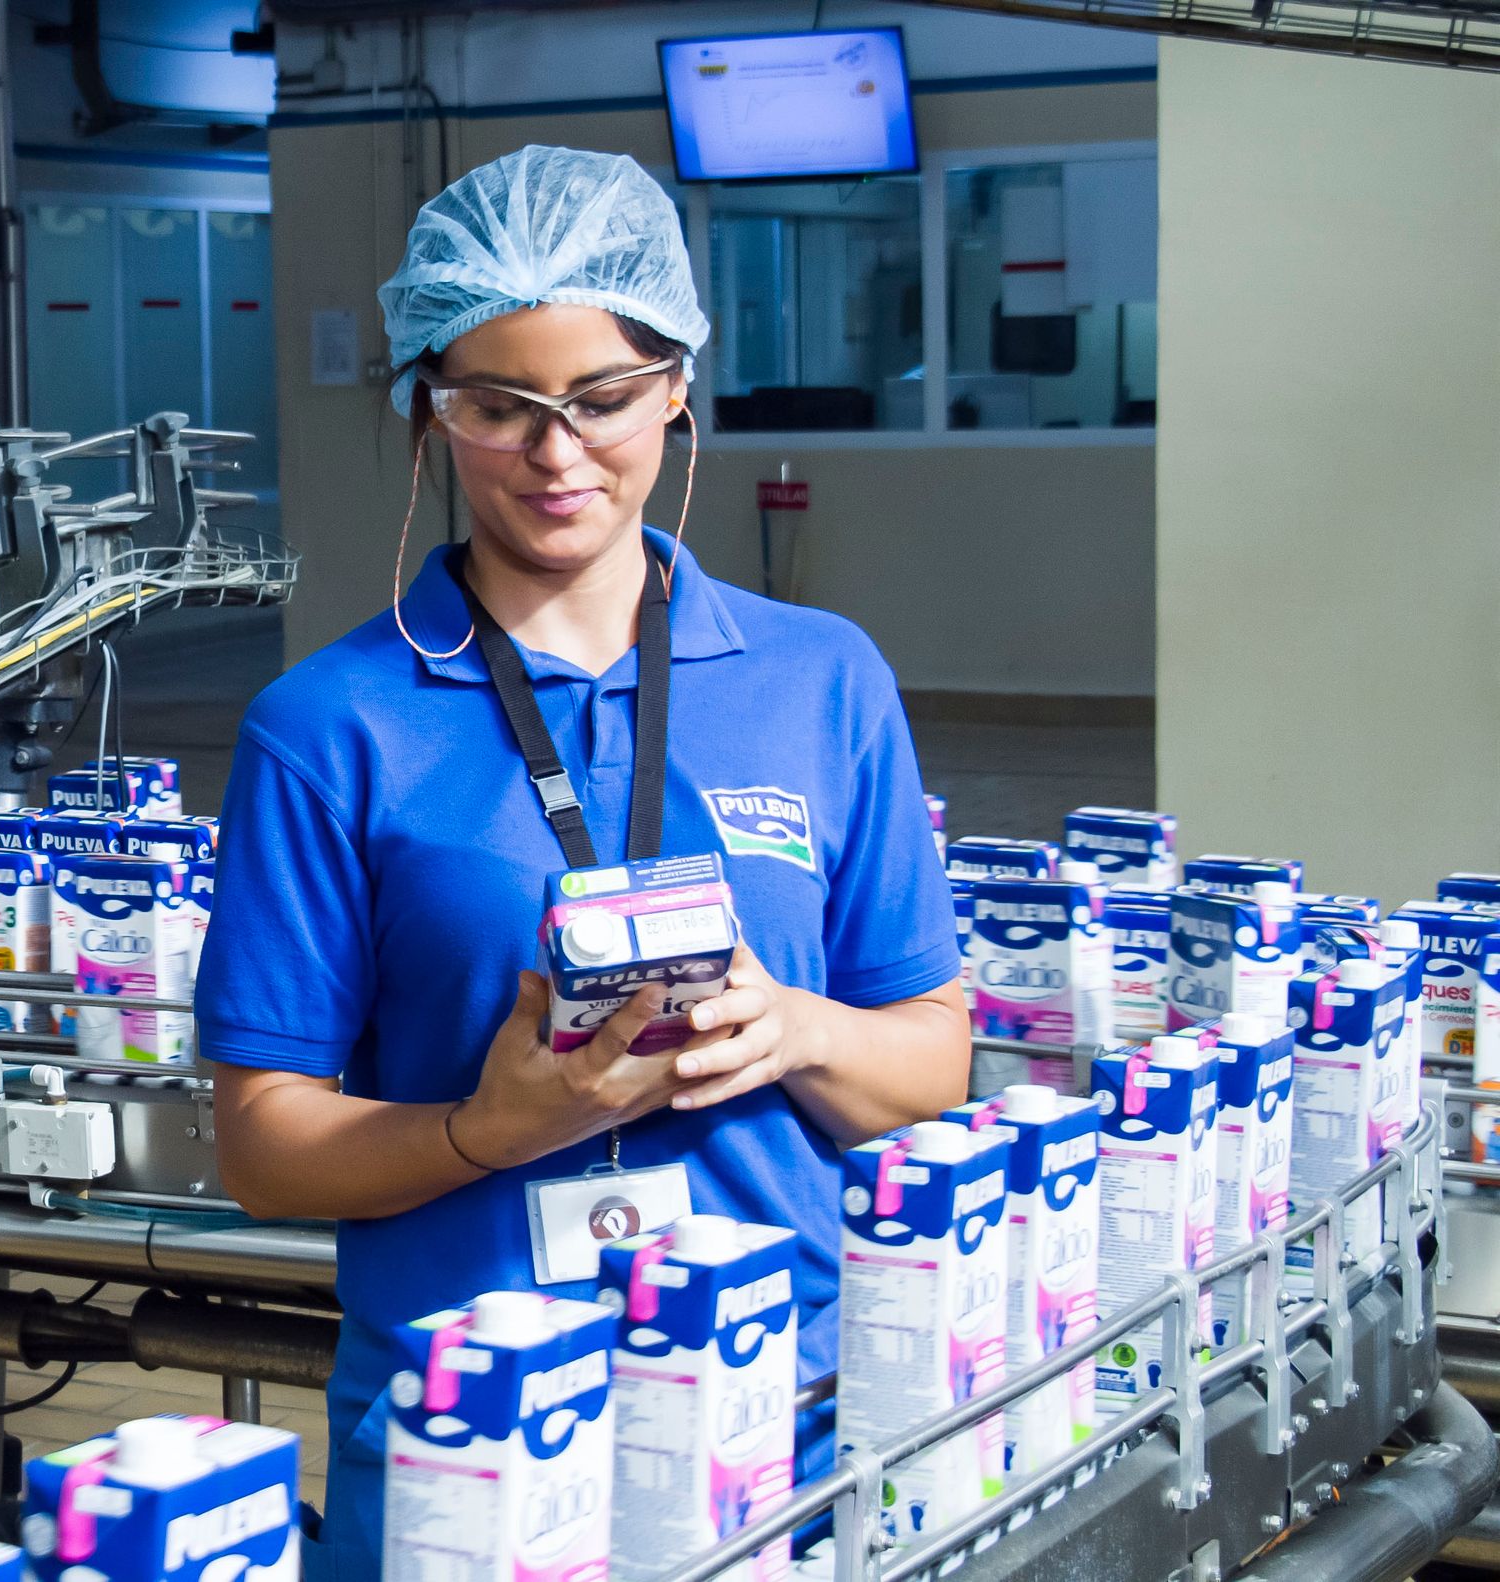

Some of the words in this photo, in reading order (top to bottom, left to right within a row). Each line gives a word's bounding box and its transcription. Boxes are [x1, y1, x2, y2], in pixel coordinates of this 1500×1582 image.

[716, 795, 805, 824] PULEVA
[41, 832, 105, 853] PULEVA
[1067, 829, 1149, 854] PULEVA
[75, 875, 153, 897] PULEVA
[3, 906, 16, 928] 3
[974, 898, 1068, 923] PULEVA
[80, 927, 151, 955] Calcio
[572, 961, 716, 993] PULEVA
[980, 959, 1067, 989] Calcio
[164, 1482, 290, 1572] PULEVA
